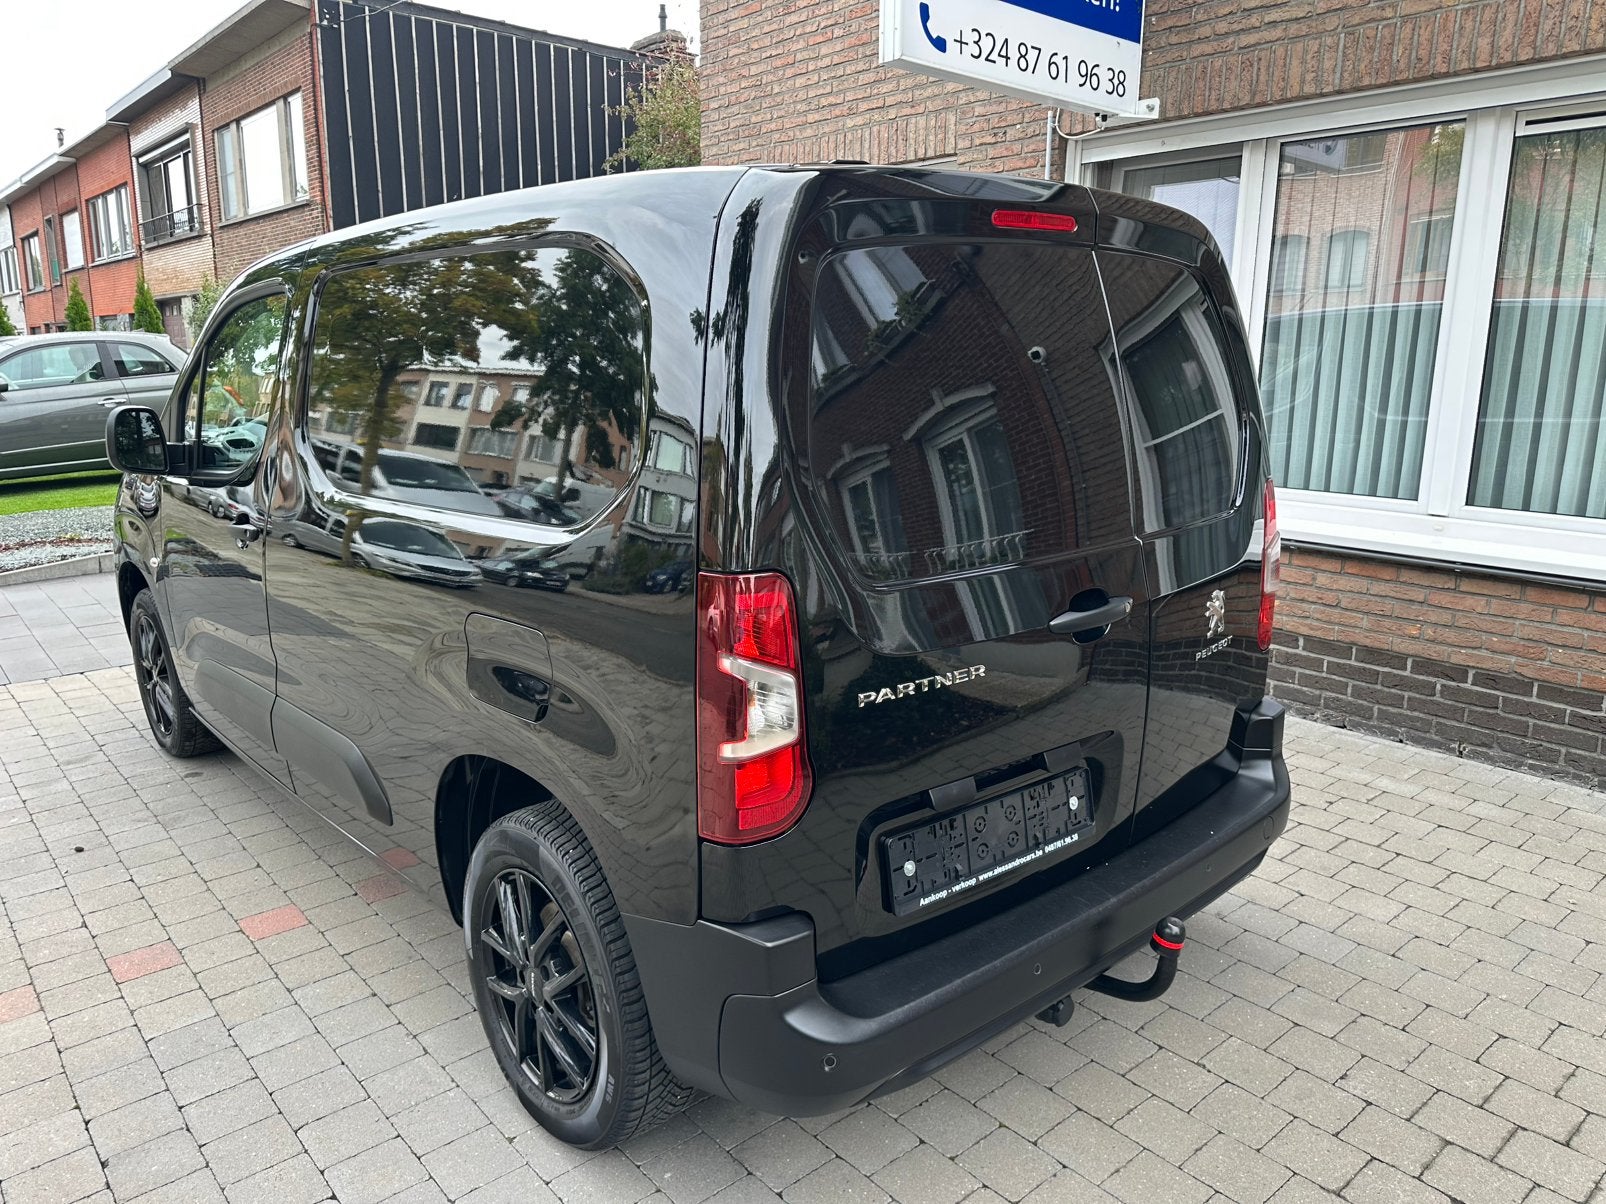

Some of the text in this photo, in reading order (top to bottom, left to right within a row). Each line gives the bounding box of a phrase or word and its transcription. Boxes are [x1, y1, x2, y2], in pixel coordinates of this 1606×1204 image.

[953, 28, 1127, 98] +324 87 61 96 38
[1195, 635, 1233, 662] PEUGEOT
[858, 664, 987, 708] PARTNER
[919, 888, 948, 907] Aankoop
[952, 877, 976, 892] verkoop
